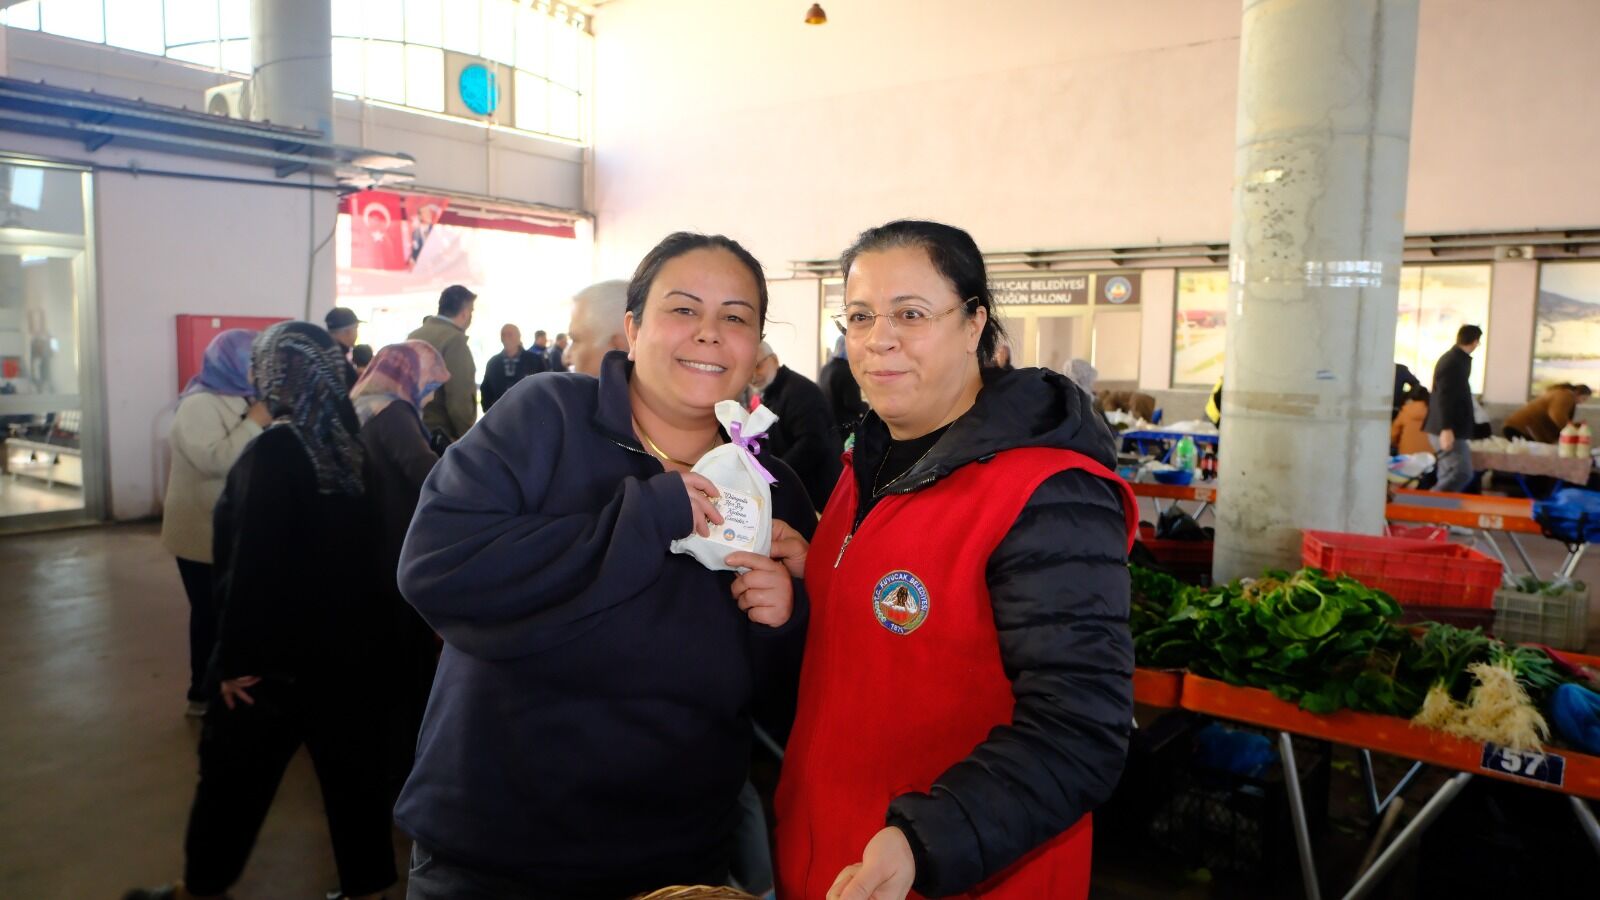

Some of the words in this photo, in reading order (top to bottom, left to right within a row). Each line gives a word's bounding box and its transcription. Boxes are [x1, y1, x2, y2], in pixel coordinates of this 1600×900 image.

[1031, 278, 1085, 290] BELEDİYESİ
[1031, 292, 1072, 304] SALONU
[879, 573, 908, 589] KUYUCAK
[1500, 747, 1544, 776] 57
